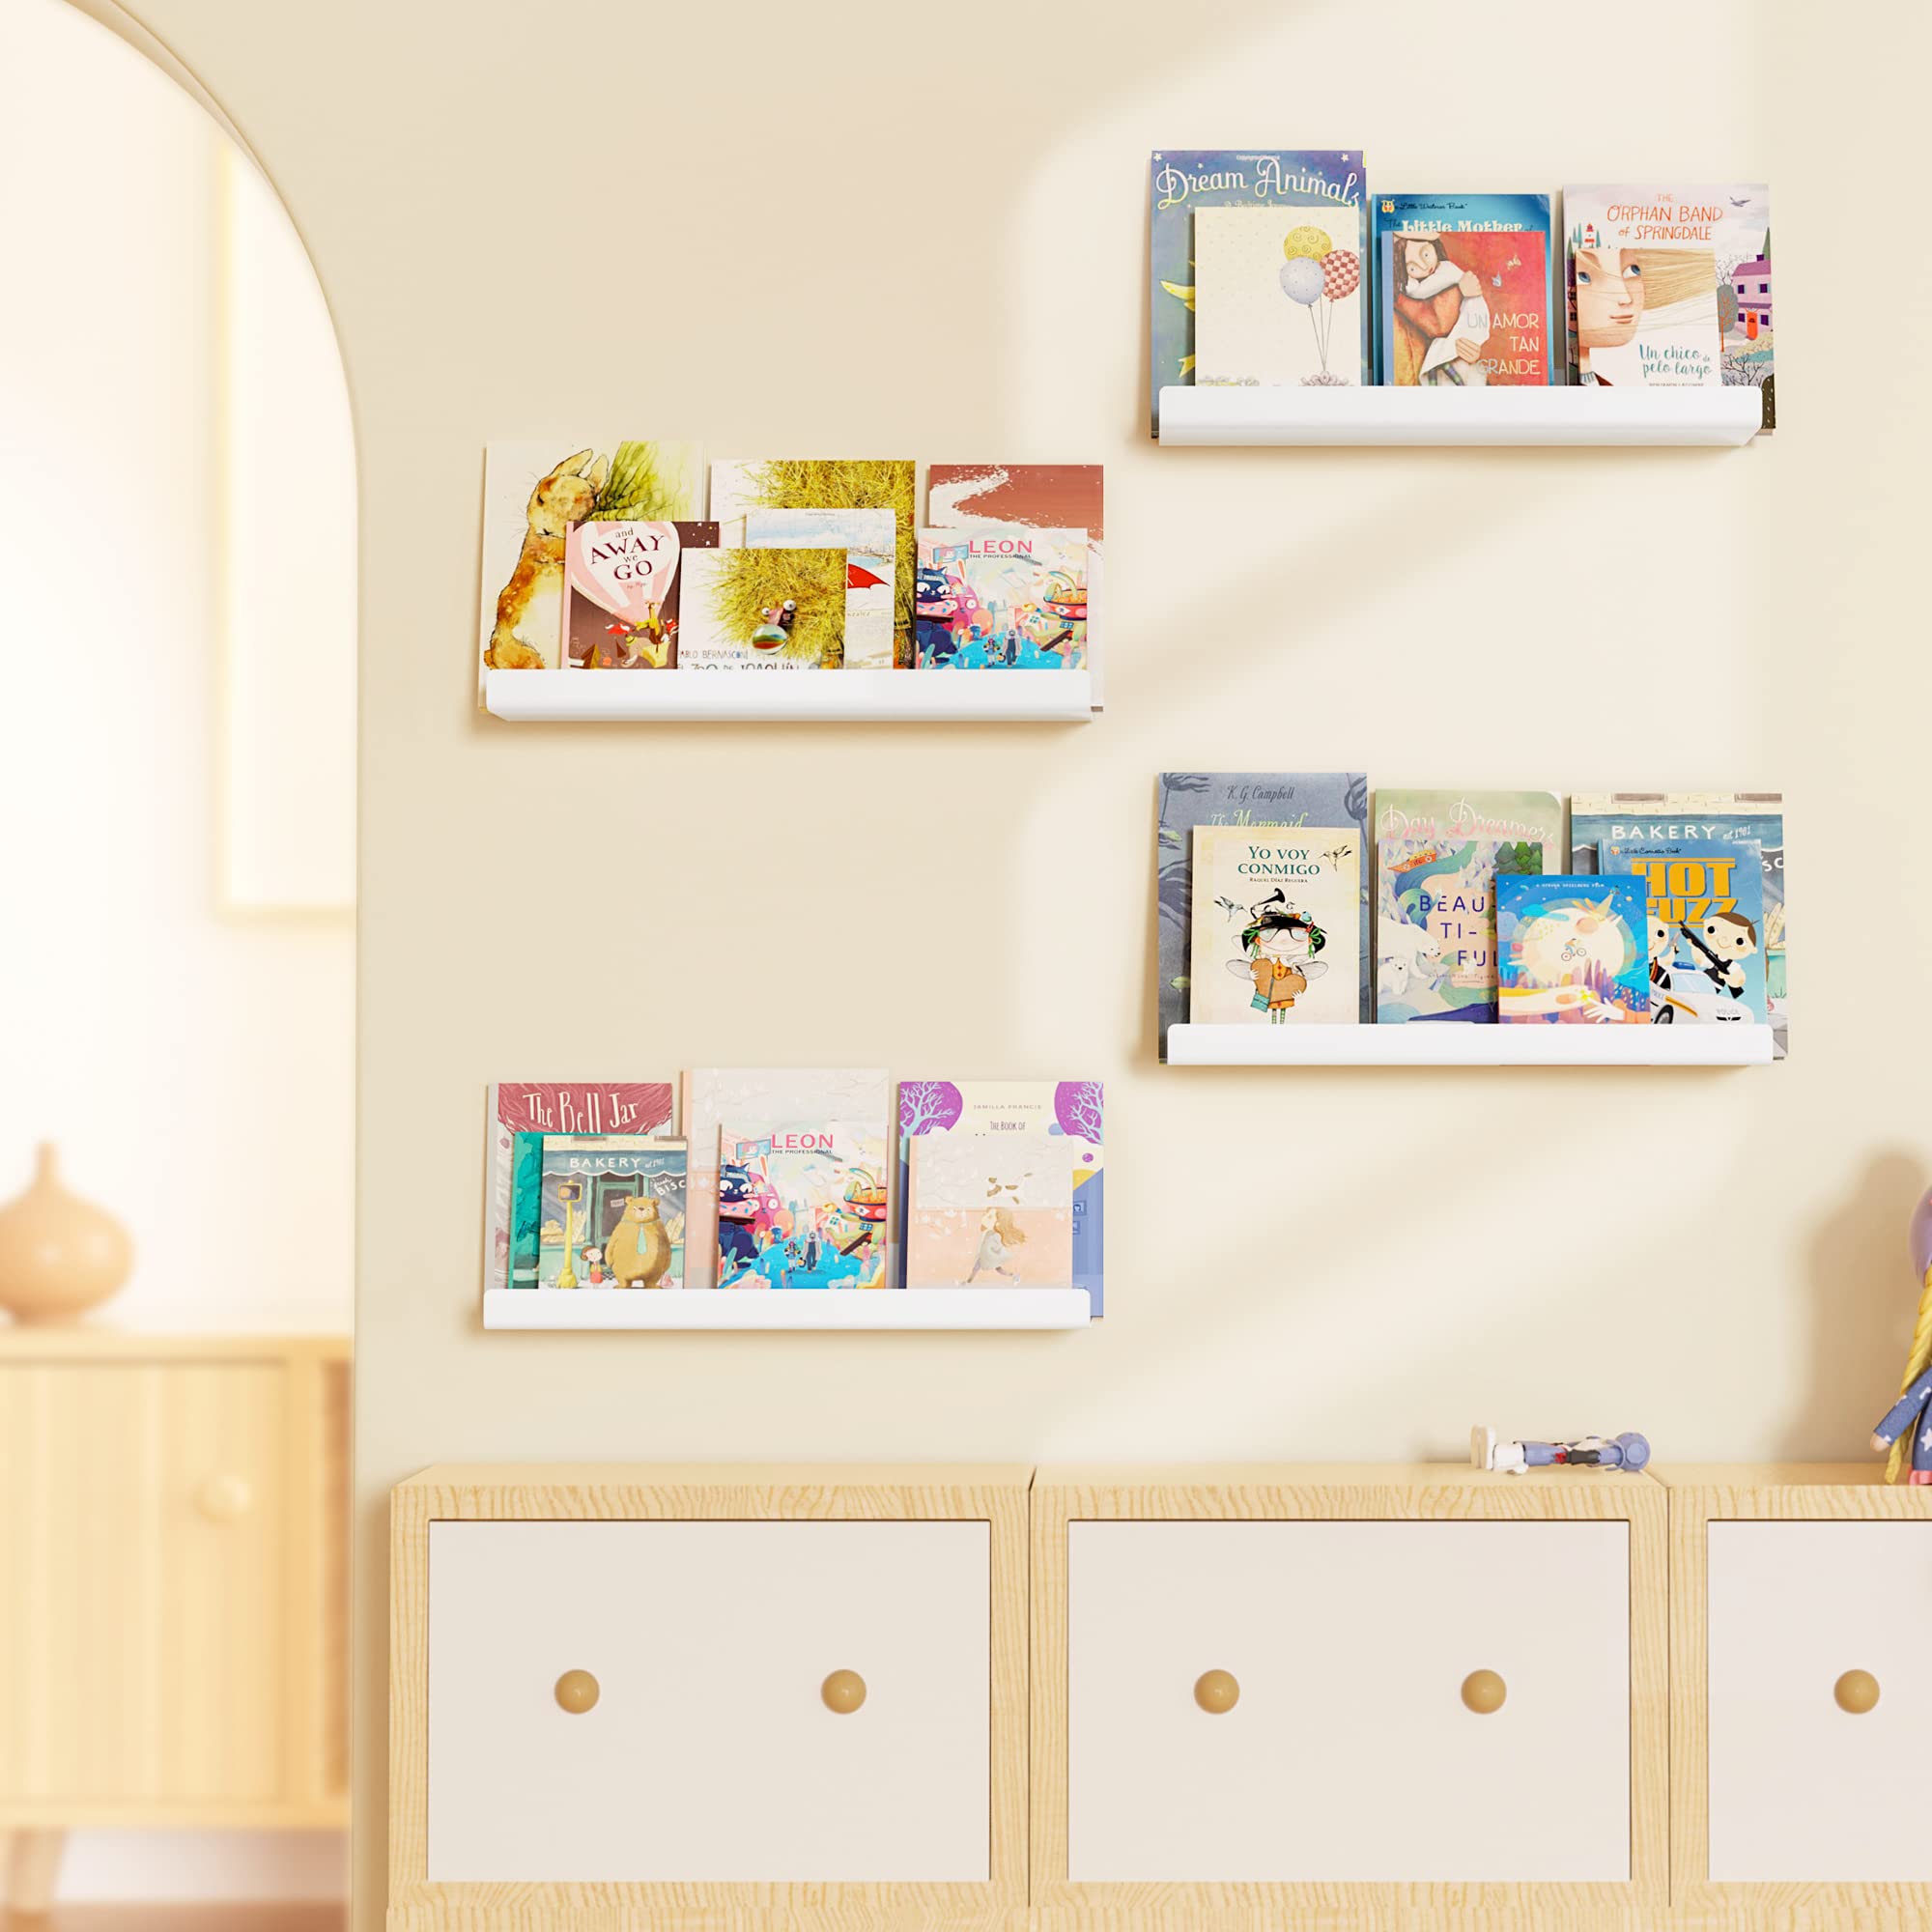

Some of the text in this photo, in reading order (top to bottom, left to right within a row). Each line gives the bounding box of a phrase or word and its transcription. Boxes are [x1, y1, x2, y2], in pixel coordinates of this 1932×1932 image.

[1156, 156, 1359, 210] Dream Animals
[1657, 194, 1673, 203] THE
[1607, 205, 1723, 223] ORPHAN BAND
[1402, 219, 1453, 232] Little
[1457, 219, 1523, 232] Mother
[1618, 225, 1713, 241] of SPRINGDALE
[1467, 311, 1540, 329] UN AMOR
[1509, 335, 1540, 353] TAN
[1639, 343, 1661, 360] Un
[1662, 345, 1701, 360] chico
[1476, 358, 1541, 375] GRANDE
[1642, 359, 1713, 380] pelo largo
[614, 526, 634, 539] and
[590, 534, 665, 565] AWAY
[969, 540, 1033, 554] LEON
[623, 554, 639, 562] we
[613, 559, 653, 581] GO
[1252, 785, 1295, 803] Campbell
[1380, 804, 1435, 840] Day
[1611, 825, 1717, 840] BAKERY
[1237, 863, 1321, 875] CONMIGO
[1631, 862, 1736, 898] HOT
[1419, 895, 1486, 912] BEAU
[1439, 923, 1477, 939] TI-
[523, 1092, 639, 1134] The Bell Jar
[771, 1134, 834, 1149] LEON
[569, 1158, 641, 1169] BAKERY
[656, 1179, 687, 1196] BISC
